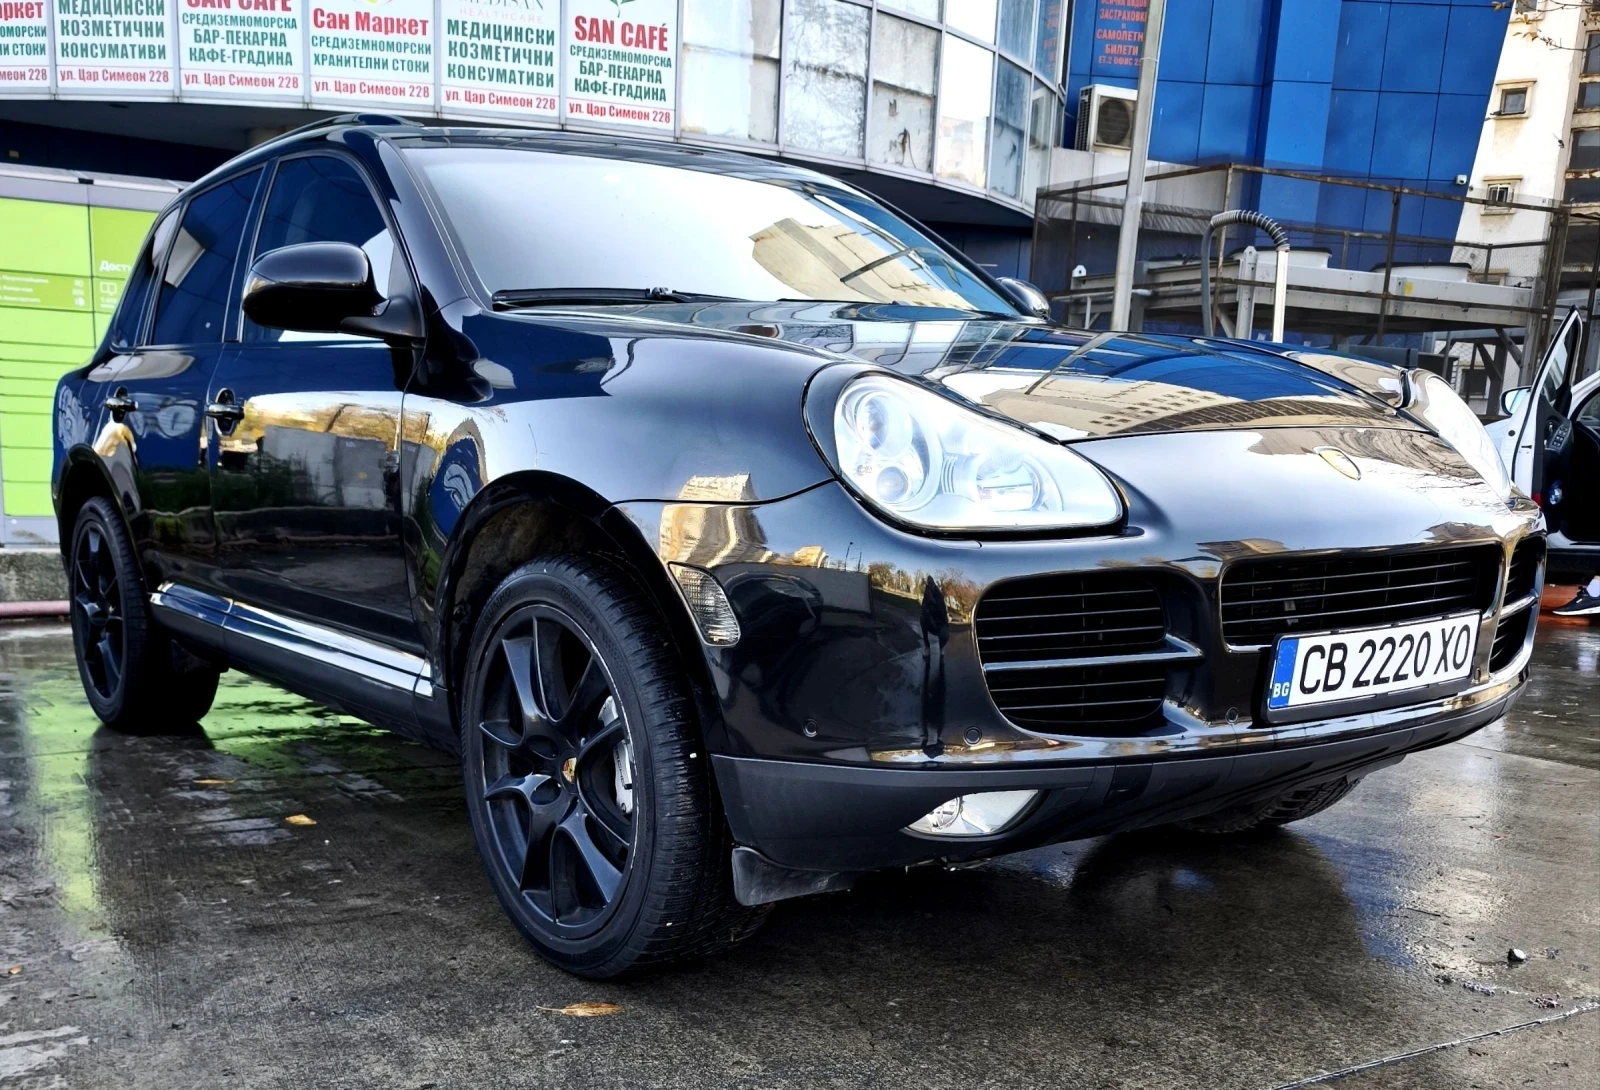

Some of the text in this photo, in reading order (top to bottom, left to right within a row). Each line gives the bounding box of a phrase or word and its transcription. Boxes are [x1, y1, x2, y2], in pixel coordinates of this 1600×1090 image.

[0, 2, 43, 20] ркет
[58, 0, 165, 18] МЕДИЦИНСКИ
[459, 8, 543, 24] HEALTHCARE
[60, 19, 165, 38] КОЗМЕТИЧНИ
[182, 12, 297, 29] СРЕДИЗЕМНОМОРСКА
[313, 7, 429, 36] Сан Маркет
[0, 26, 47, 37] ОМОРСКИ
[193, 28, 287, 47] БАР-ПЕКАРНА
[447, 18, 555, 46] МЕДИЦИНСКИ
[574, 15, 668, 52] SAN CAFÉ
[12, 43, 46, 56] СТОКИ
[60, 42, 166, 60] КОНСУМАТИВИ
[311, 35, 432, 55] СРЕДИЗЕМНОМОРСКИ
[448, 40, 554, 67] КОЗМЕТИЧНИ
[1104, 44, 1138, 56] БИЛЕТИ
[189, 47, 293, 67] КАФЕ-ГРАДИНА
[313, 53, 430, 74] ХРАНИТЕЛНИ СТОКИ
[570, 44, 672, 68] СРЕДИЗЕМНОМОРСКА
[0, 68, 47, 81] меон 228
[60, 68, 169, 83] ул. Цар Симеон 228
[184, 72, 299, 89] ул. Цар Симеон 228
[447, 63, 554, 88] КОНСУМАТИВИ
[579, 60, 662, 84] БАР-ПЕКАРНА
[314, 80, 430, 98] ул. Цар Симеон 228
[574, 78, 667, 102] КАФЕ-ГРАДИНА
[445, 90, 556, 110] ул. Цар Симеон 228
[569, 102, 671, 124] ул. Цар Симеон 228
[1299, 624, 1471, 695] CB 2220 XO
[1272, 682, 1290, 698] BG
